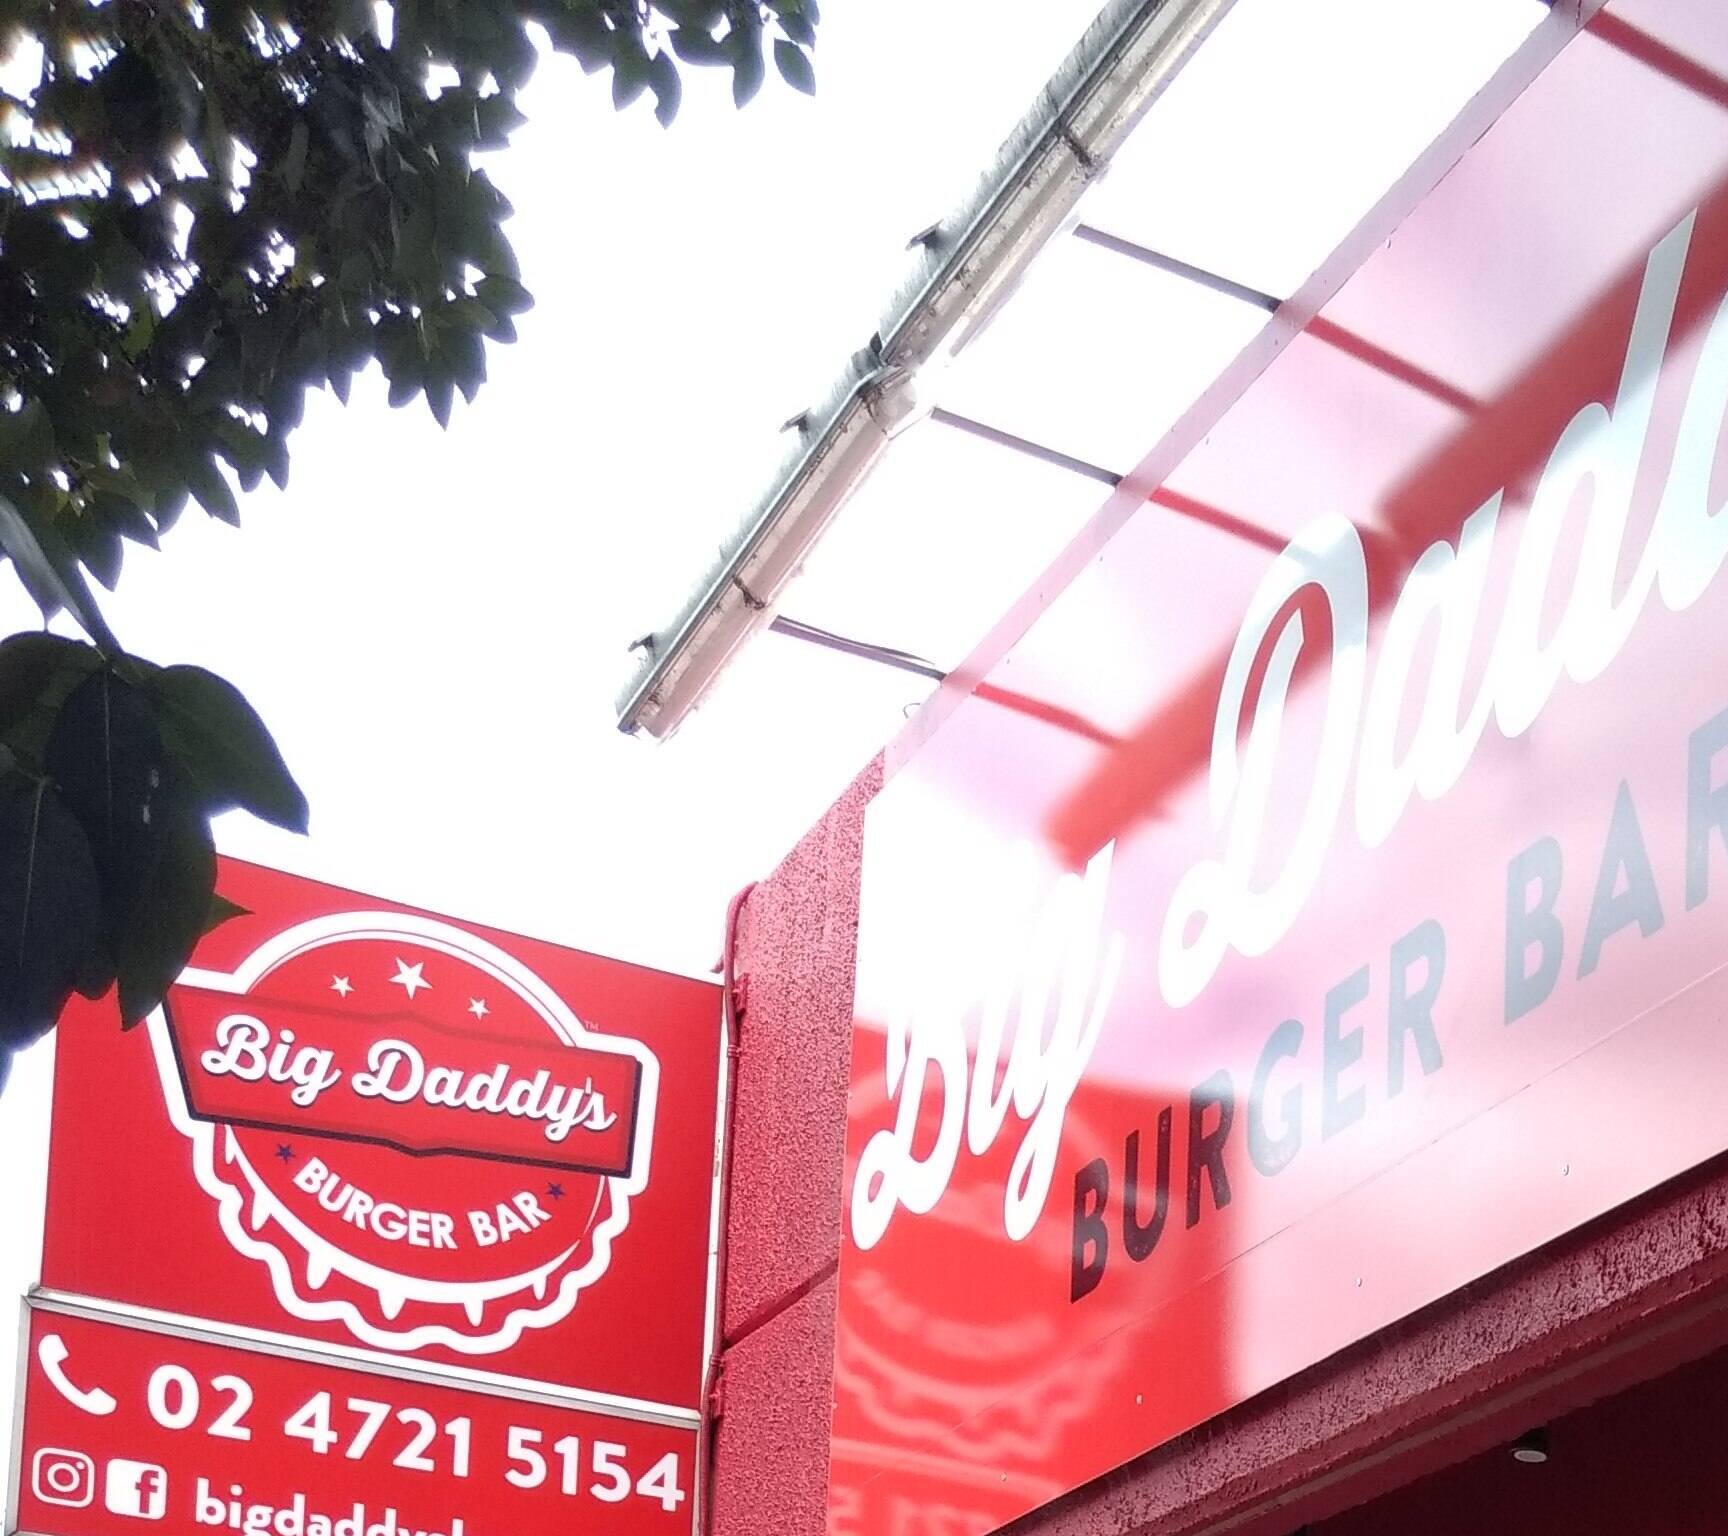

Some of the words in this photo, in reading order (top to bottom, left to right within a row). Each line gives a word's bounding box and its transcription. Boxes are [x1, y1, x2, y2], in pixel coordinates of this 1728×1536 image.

[200, 1013, 344, 1106] Big
[351, 1036, 619, 1143] Daddy's
[1067, 916, 1448, 1304] BURGER
[292, 1156, 459, 1251] BURGER
[468, 1190, 552, 1249] BAR
[147, 1363, 253, 1442] 02
[283, 1391, 473, 1478] 4721
[504, 1427, 686, 1513] 5154
